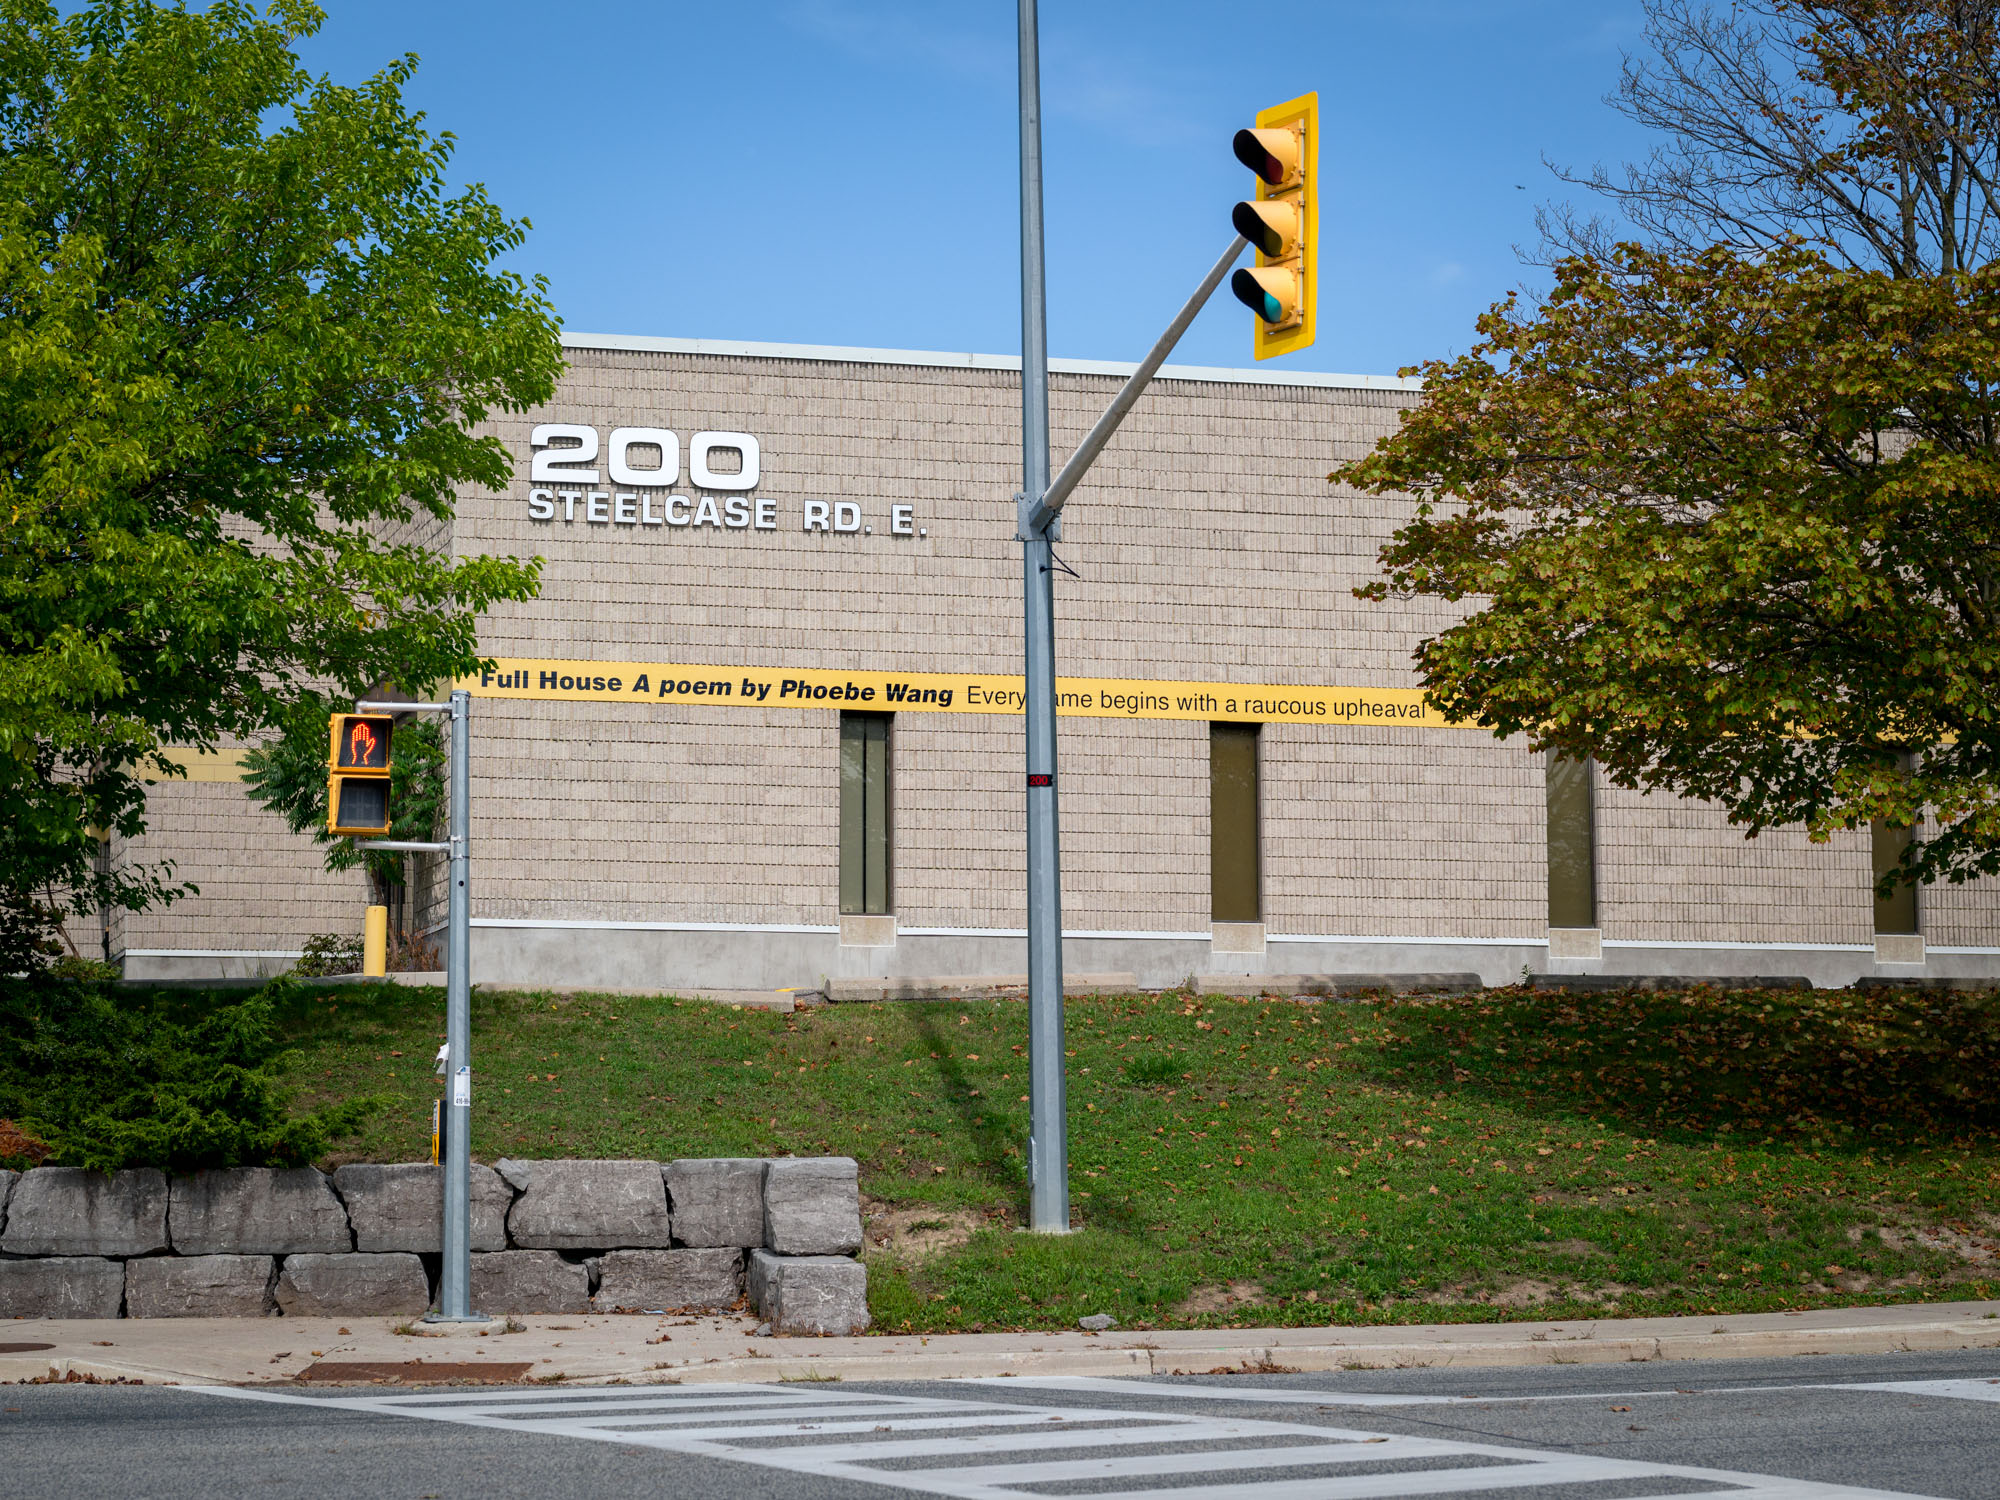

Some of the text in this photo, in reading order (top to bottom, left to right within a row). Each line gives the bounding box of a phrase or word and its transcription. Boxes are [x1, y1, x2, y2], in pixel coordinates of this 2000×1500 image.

[530, 423, 760, 490] 200
[528, 488, 927, 535] STEELCASE RD. E.
[481, 669, 528, 688] Full
[540, 671, 622, 692] House
[632, 674, 650, 692] A
[659, 678, 732, 697] poem
[740, 678, 771, 701] by
[779, 679, 875, 701] Phoebe
[886, 683, 953, 707] Wang
[967, 685, 1025, 710] Every
[1101, 690, 1169, 714] begins
[1176, 693, 1217, 711] with
[1225, 699, 1237, 713] a
[1245, 699, 1326, 714] raucous
[1334, 698, 1425, 720] upheaval
[1030, 775, 1048, 785] 200
